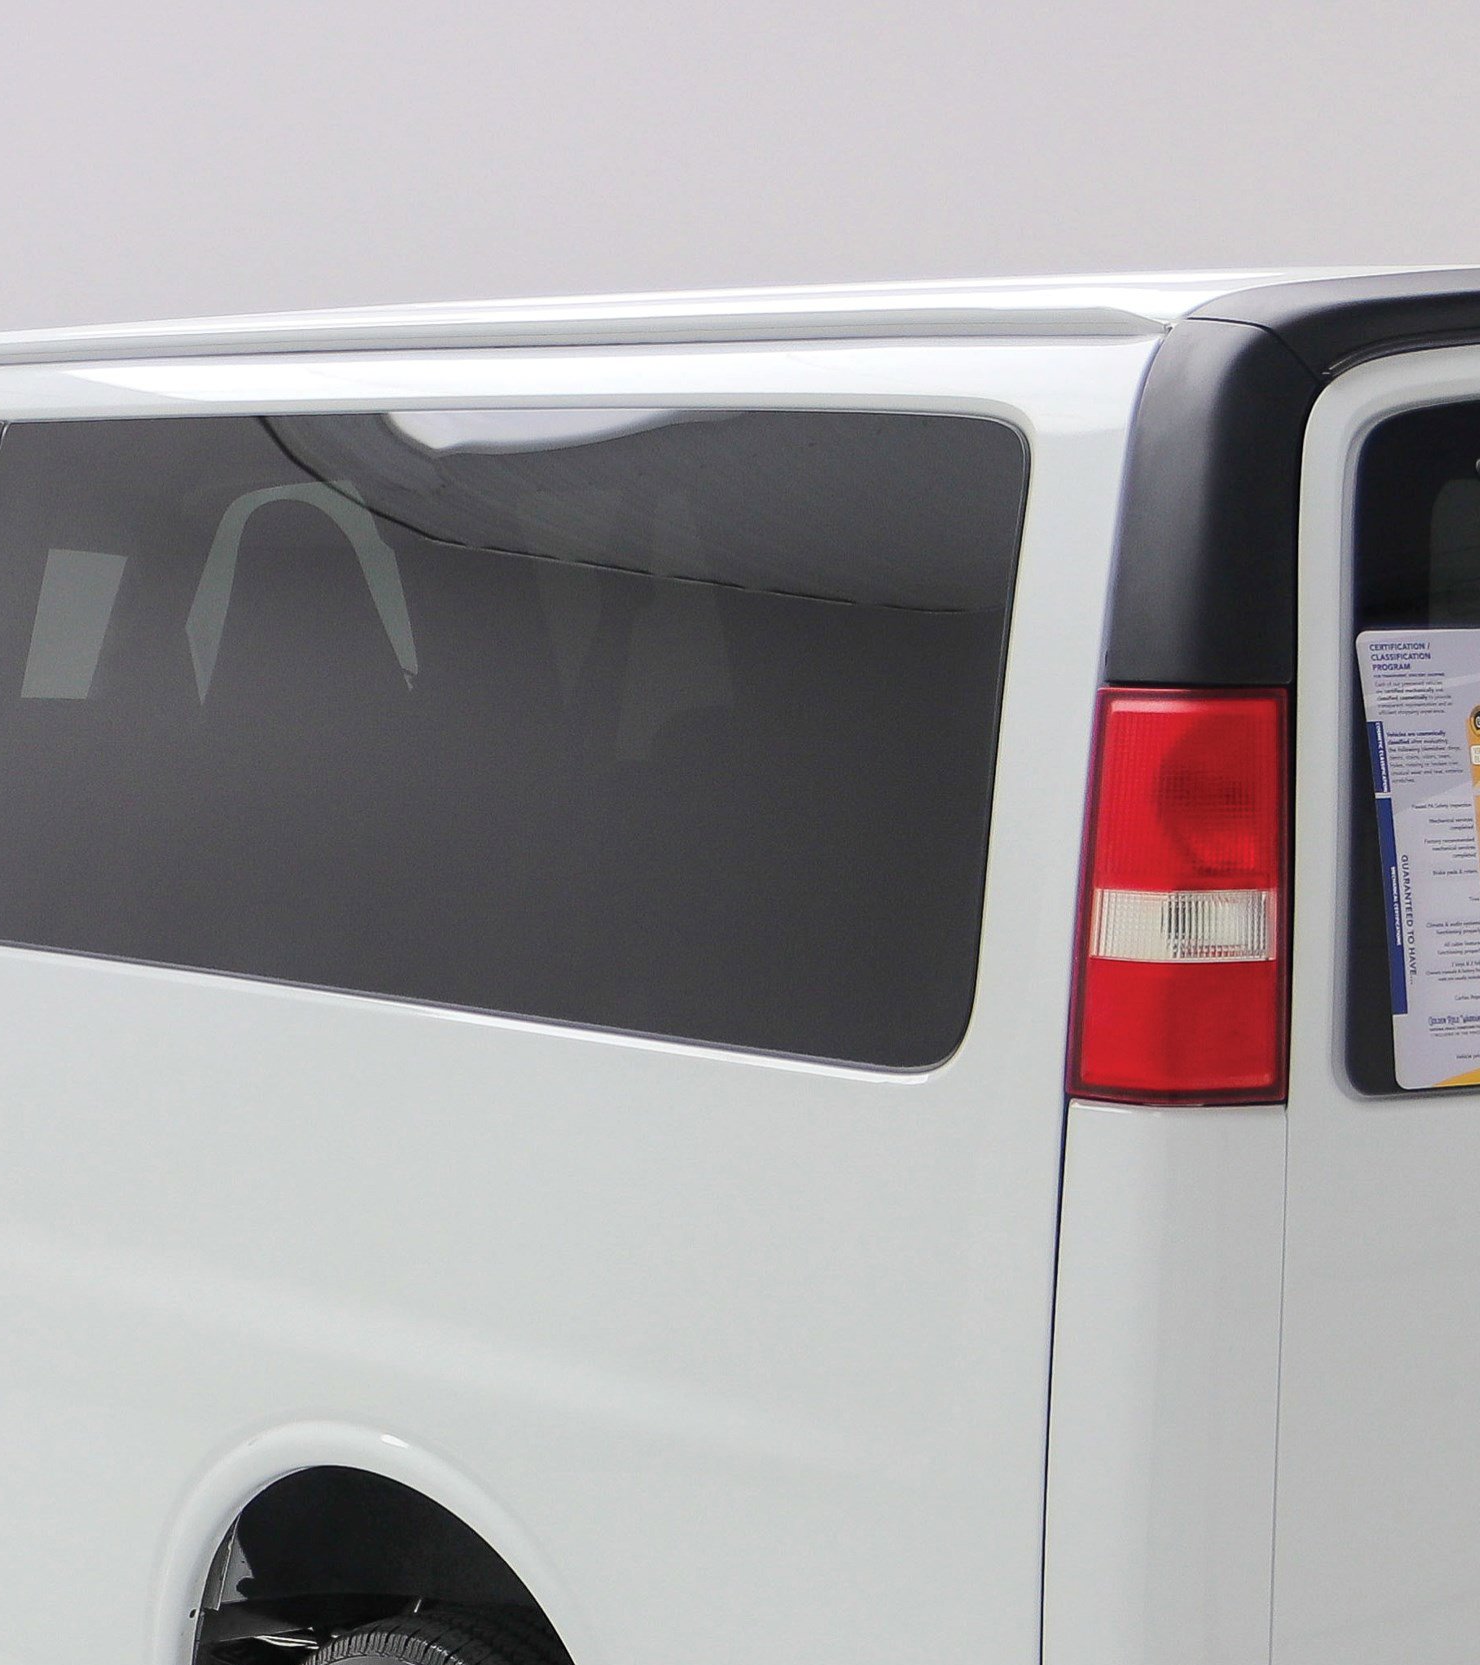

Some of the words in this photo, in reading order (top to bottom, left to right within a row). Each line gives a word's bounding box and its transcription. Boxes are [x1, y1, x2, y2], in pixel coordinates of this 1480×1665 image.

[1369, 643, 1425, 651] CERTIFICATION
[1371, 652, 1431, 661] CLASSIFICATION
[1372, 663, 1411, 671] PROGRAM
[1401, 854, 1414, 927] GUARANTEED
[1407, 930, 1415, 945] TO
